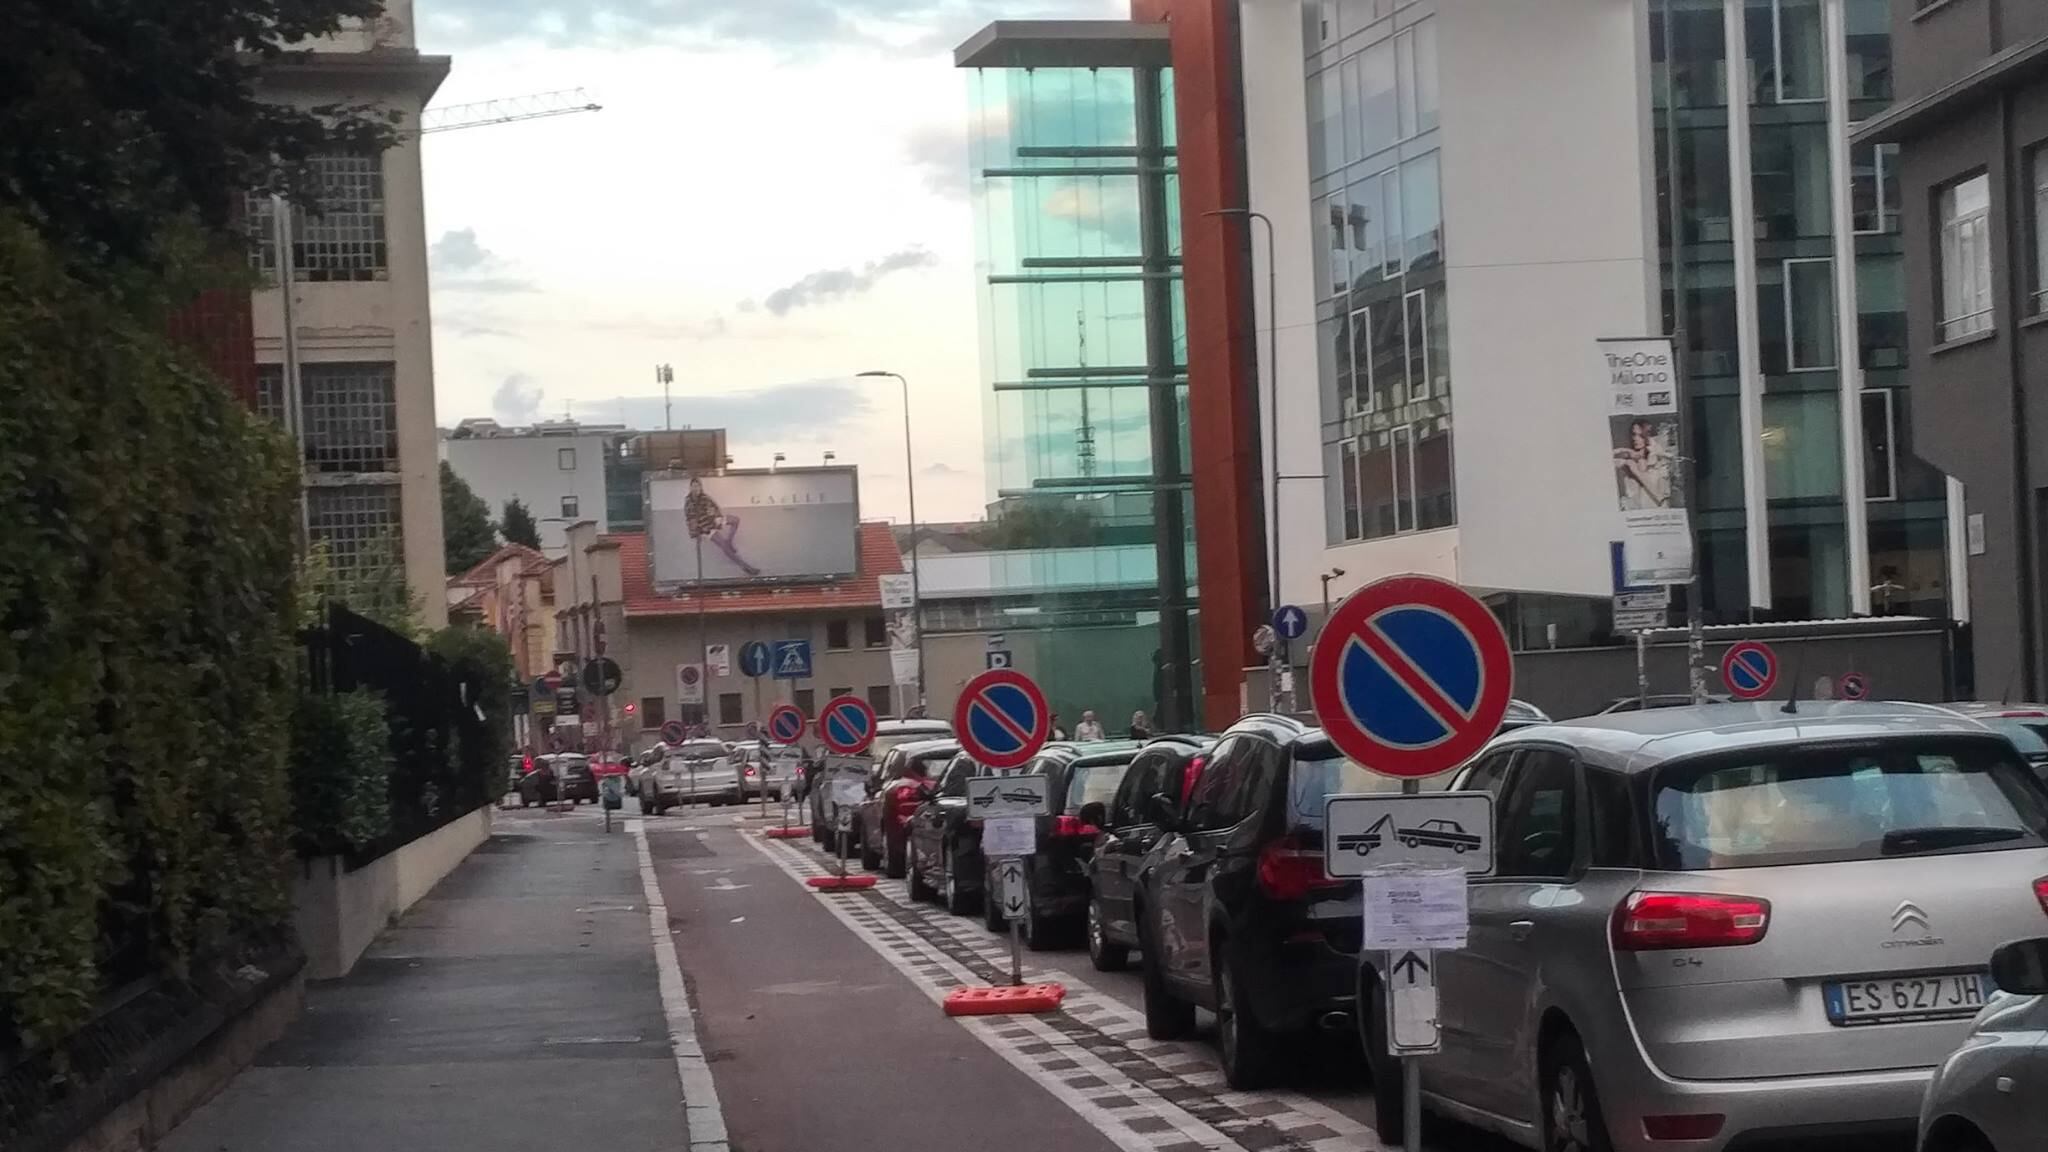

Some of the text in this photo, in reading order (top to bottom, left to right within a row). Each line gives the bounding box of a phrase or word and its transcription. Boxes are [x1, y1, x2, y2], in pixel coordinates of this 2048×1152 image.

[1604, 352, 1667, 368] TheOne
[1610, 369, 1667, 385] Milano
[1672, 956, 1704, 968] C4
[1847, 975, 1982, 1012] ES 627 JH
